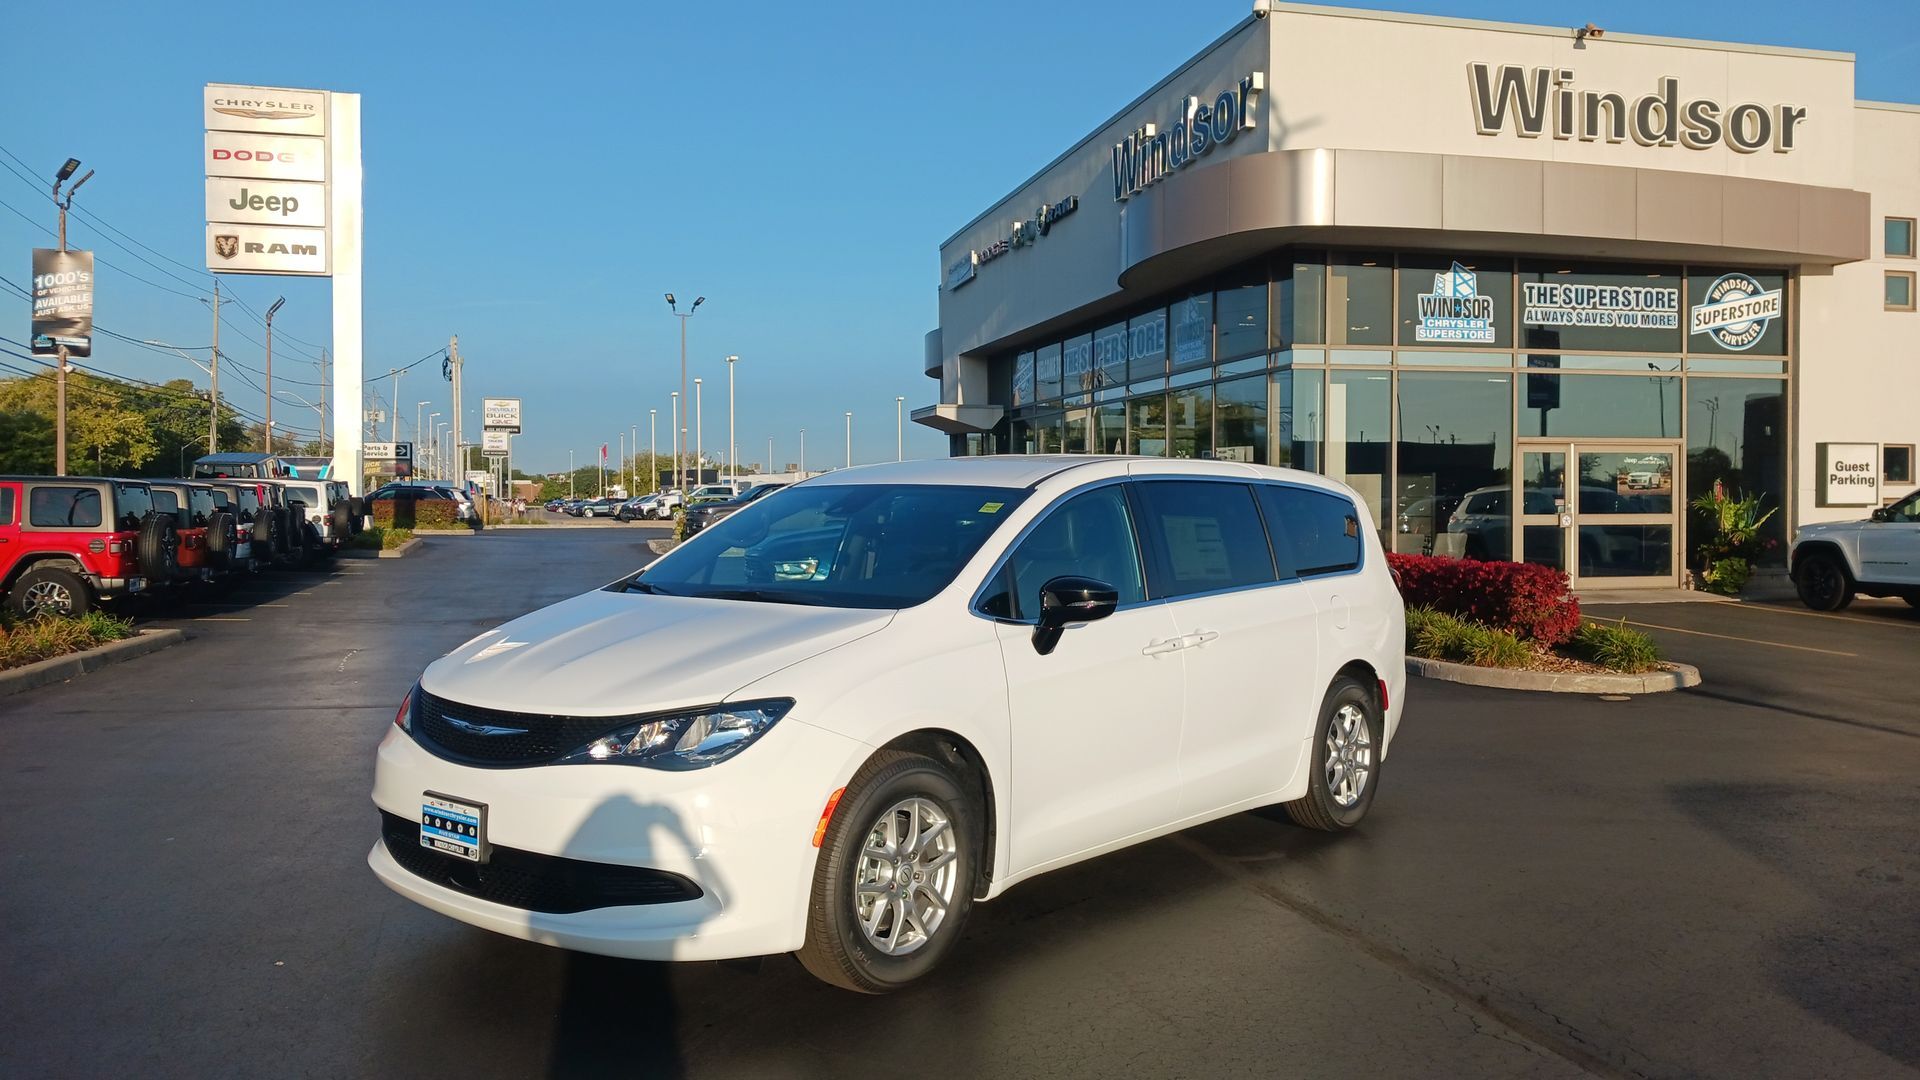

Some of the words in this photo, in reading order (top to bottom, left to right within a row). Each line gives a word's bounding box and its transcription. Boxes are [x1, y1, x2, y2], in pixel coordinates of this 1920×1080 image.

[214, 98, 315, 111] CHRYSLER
[1466, 61, 1808, 154] Windsor
[1111, 71, 1264, 203] Windsor
[212, 148, 312, 164] DODG
[229, 187, 299, 217] Jeep
[244, 241, 318, 256] RAM
[34, 271, 89, 288] 1000's
[49, 283, 87, 294] VEHICLES
[1712, 279, 1754, 300] WINDSOR
[35, 293, 89, 309] AVAILABLE
[1526, 285, 1558, 305] THE
[1562, 286, 1676, 309] SUPERSTORE
[35, 308, 57, 317] JUST
[58, 305, 75, 313] ASK
[77, 303, 89, 311] US
[1420, 297, 1491, 319] WINDSOR
[1695, 297, 1778, 327] SUPERSTORE
[1427, 319, 1484, 328] CHRYSLER
[1526, 310, 1573, 323] ALWAYS
[1576, 311, 1614, 324] SAVES
[1616, 313, 1638, 325] YOU
[1641, 314, 1677, 326] MORE!
[1419, 329, 1492, 339] SUPERSTORE
[1719, 322, 1762, 346] CHRYSLER
[1080, 318, 1165, 373] SUPERSTORE
[1834, 460, 1870, 472] Guest
[1829, 474, 1875, 488] Parking
